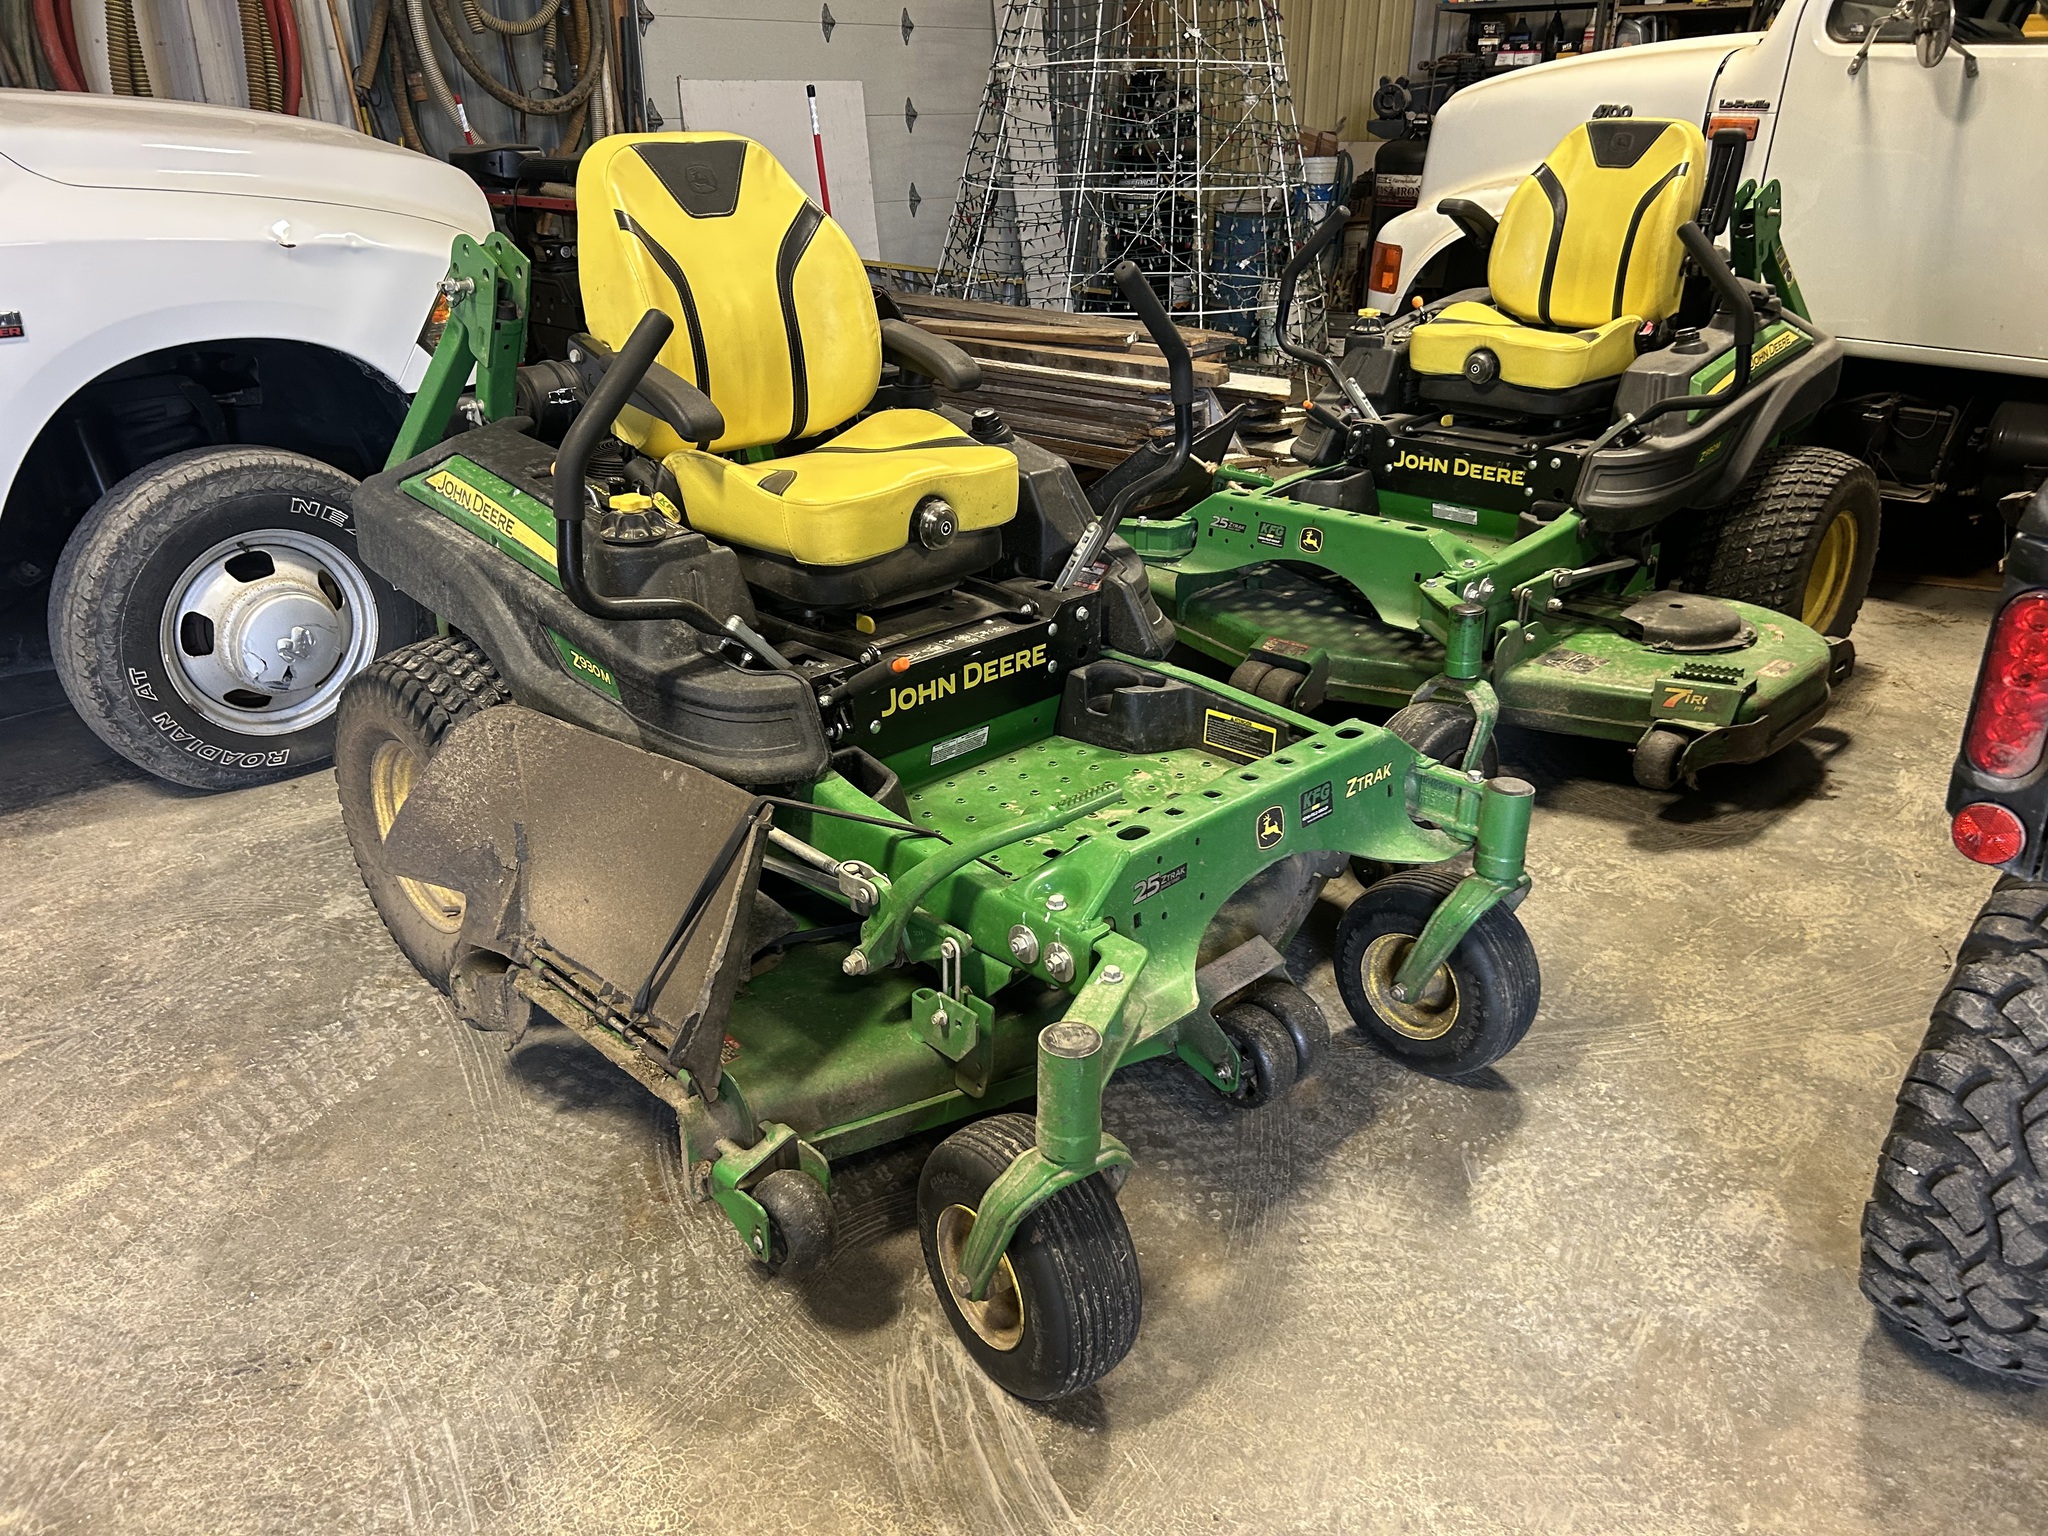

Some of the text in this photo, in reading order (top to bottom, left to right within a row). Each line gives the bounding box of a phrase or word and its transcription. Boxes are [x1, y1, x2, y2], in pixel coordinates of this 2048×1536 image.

[1592, 104, 1633, 119] 4700
[1751, 335, 1791, 370] JOHN DEERE
[1393, 450, 1527, 487] JOHN DEERE
[290, 496, 358, 536] NE
[437, 474, 516, 536] JOHN DEERE
[1210, 515, 1229, 529] 25
[1228, 522, 1246, 531] ZTRAK
[1260, 522, 1285, 537] KFG
[570, 649, 612, 685] Z930M
[881, 643, 1047, 718] JOHN DEERE
[128, 667, 291, 769] AT ROADIAN
[1302, 782, 1331, 810] KFG
[1345, 762, 1393, 799] ZTRAK
[1133, 872, 1161, 905] 25
[1160, 866, 1186, 884] ZTRAK
